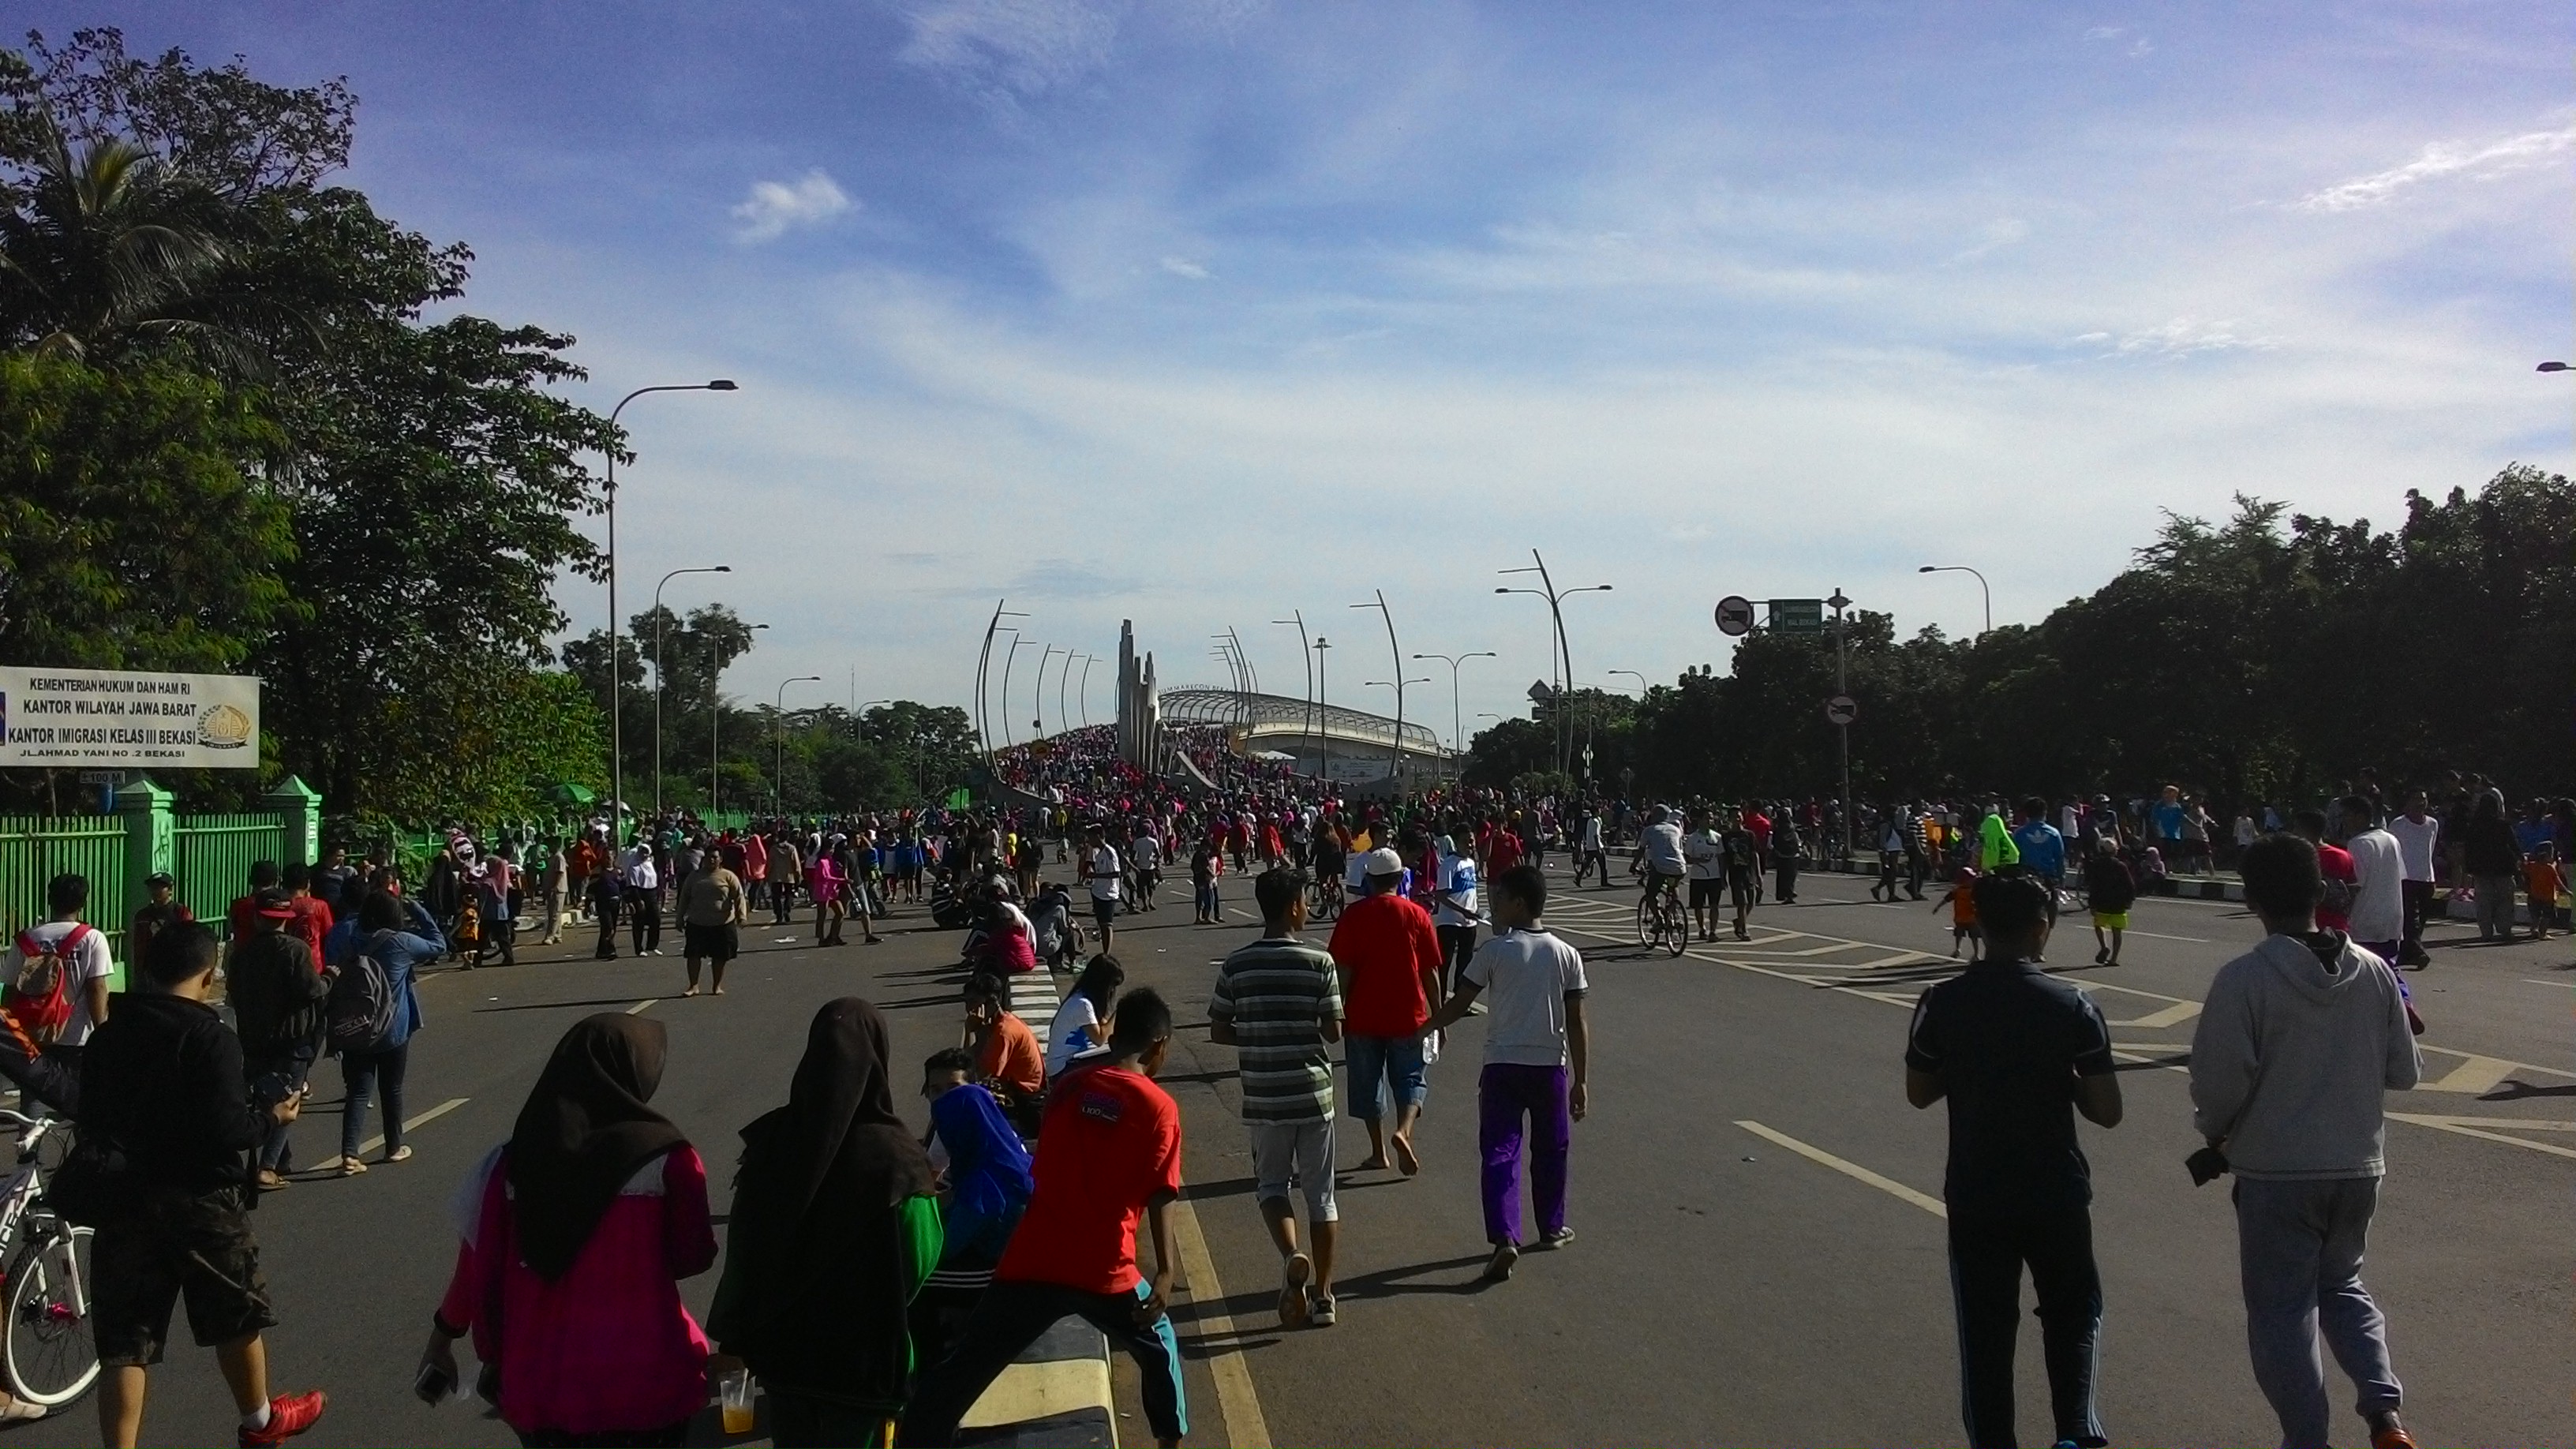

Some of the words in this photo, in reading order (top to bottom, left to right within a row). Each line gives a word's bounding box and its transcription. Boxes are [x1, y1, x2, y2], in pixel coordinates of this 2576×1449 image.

[30, 678, 97, 692] KEMENTERIAN
[99, 680, 134, 693] HUKUM
[137, 681, 156, 694] DAN
[159, 682, 178, 695] HAM
[181, 683, 190, 695] RI
[24, 699, 72, 714] KANTOR
[76, 700, 125, 715] WILAYAH
[129, 702, 160, 715] JAWA
[162, 702, 197, 717] BARAT
[9, 728, 54, 743] KANTOR
[58, 728, 107, 743] IMIGRASI
[110, 728, 144, 743] KELAS
[146, 729, 156, 744] III
[159, 730, 196, 745] BEKASI
